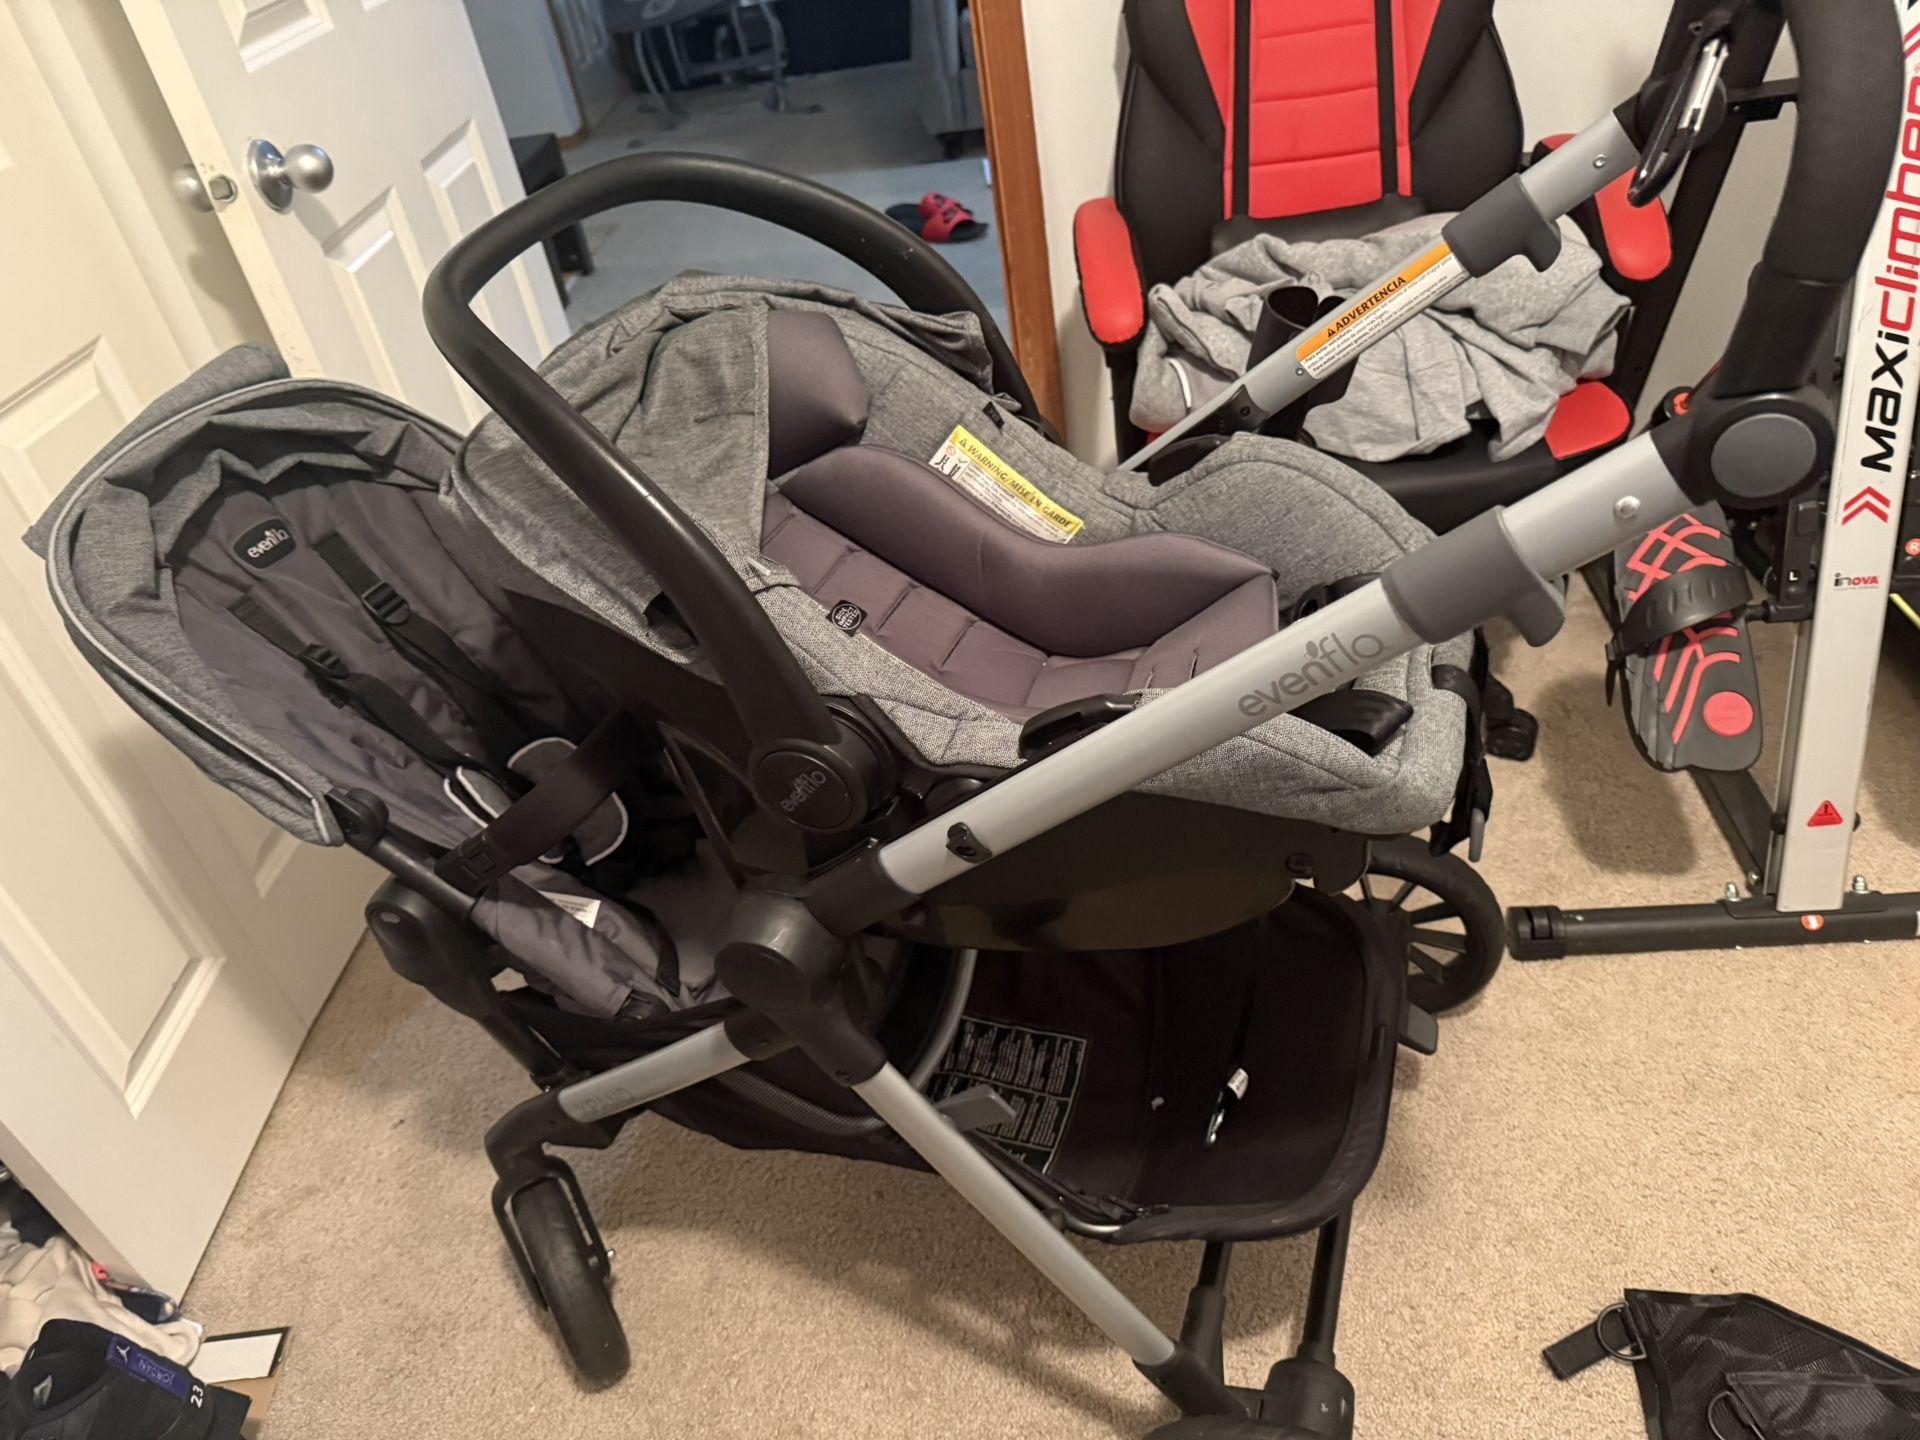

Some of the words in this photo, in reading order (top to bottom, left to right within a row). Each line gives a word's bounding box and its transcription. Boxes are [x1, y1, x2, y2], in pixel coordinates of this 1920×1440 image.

[1335, 276, 1406, 331] ADVERTENCIA
[1029, 496, 1042, 508] EN
[1041, 504, 1072, 529] GARDE
[1911, 543, 1920, 553] R
[1789, 571, 1798, 581] L
[837, 606, 854, 626] IMPACT
[1238, 632, 1384, 717] evenflo
[190, 1384, 204, 1408] 23
